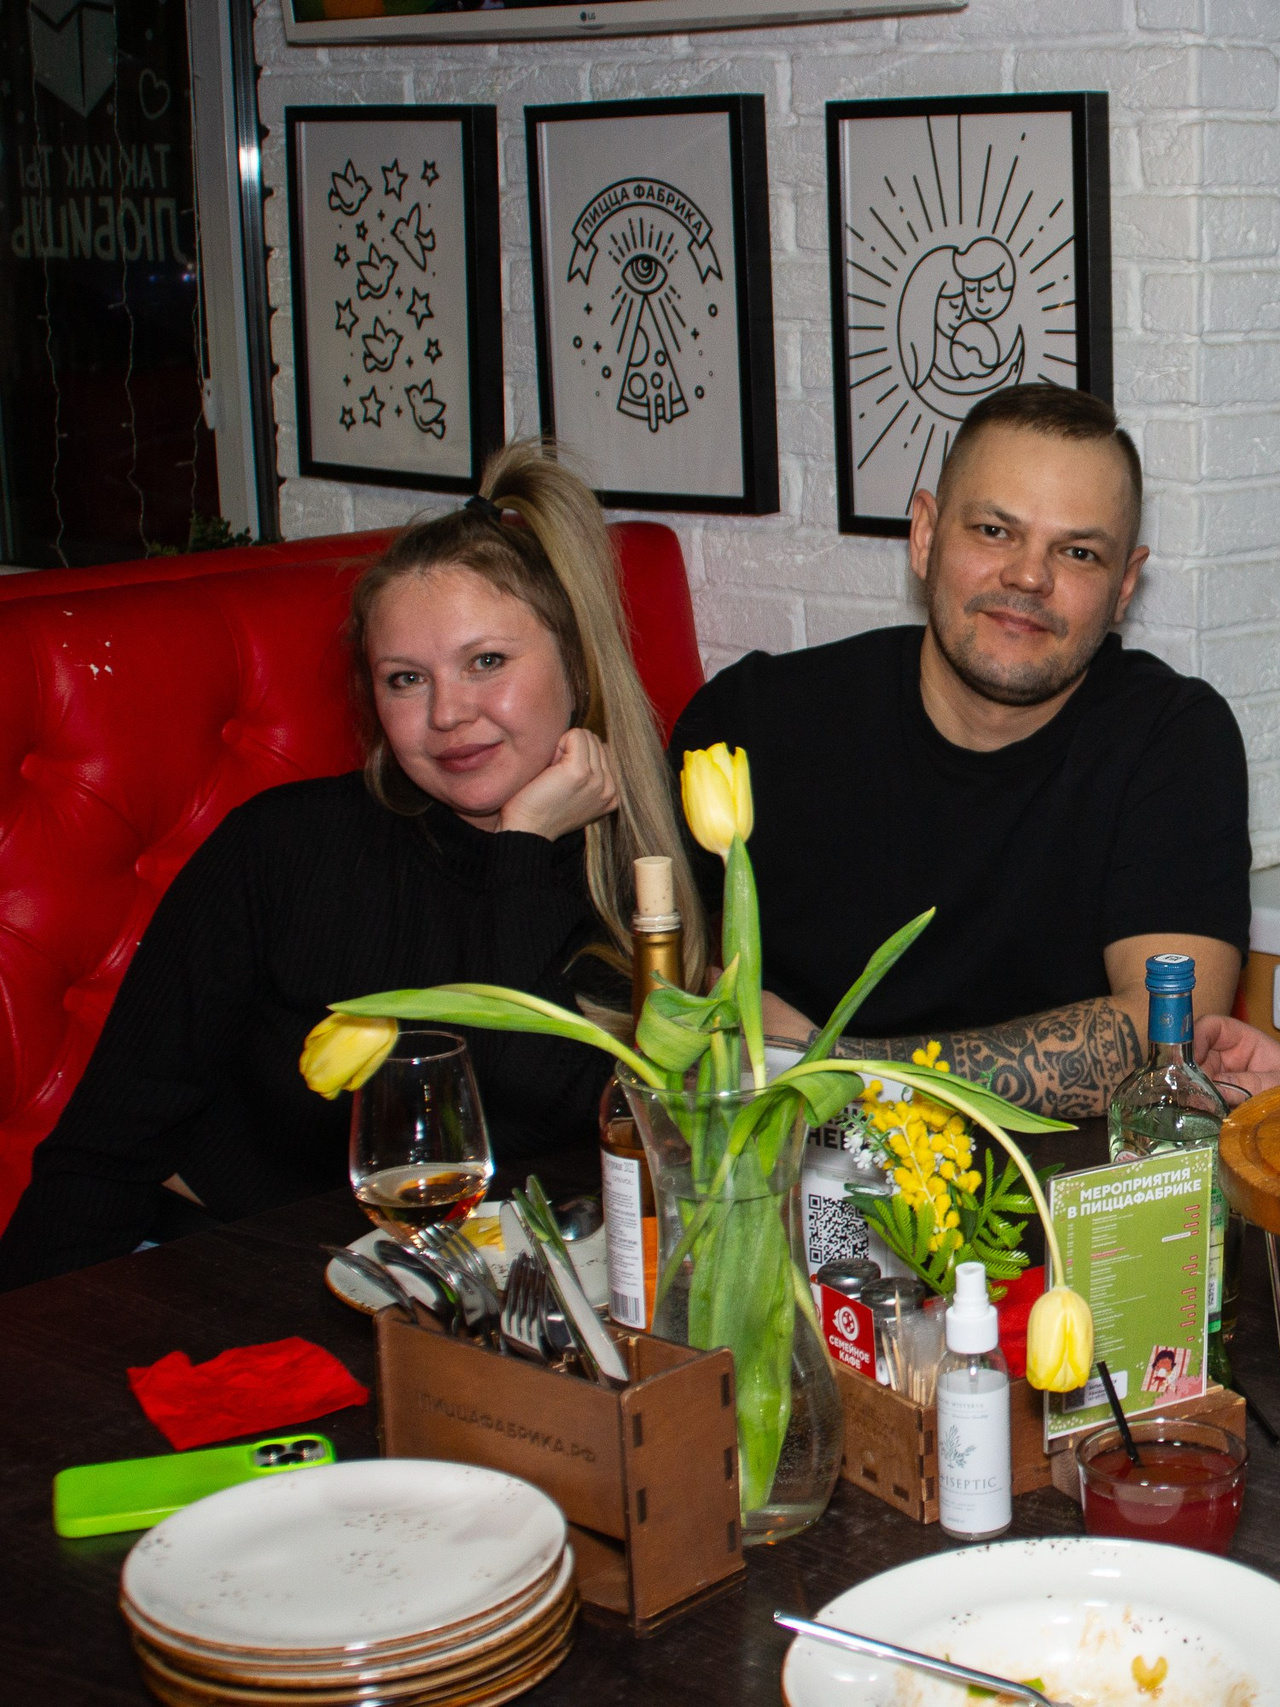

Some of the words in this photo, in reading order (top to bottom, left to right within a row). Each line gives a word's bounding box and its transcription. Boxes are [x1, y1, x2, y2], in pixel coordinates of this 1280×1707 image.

[580, 186, 630, 235] ПИЦЦА
[632, 184, 704, 236] ФАБРИКА
[1067, 1206, 1078, 1219] В
[1080, 1179, 1202, 1216] ПИЦЦАФАБРИКЕ
[1079, 1167, 1191, 1202] МЕРОПРИЯТИЯ
[828, 1334, 871, 1364] СЕМЕЙНОЕ
[839, 1350, 862, 1370] КАФЕ
